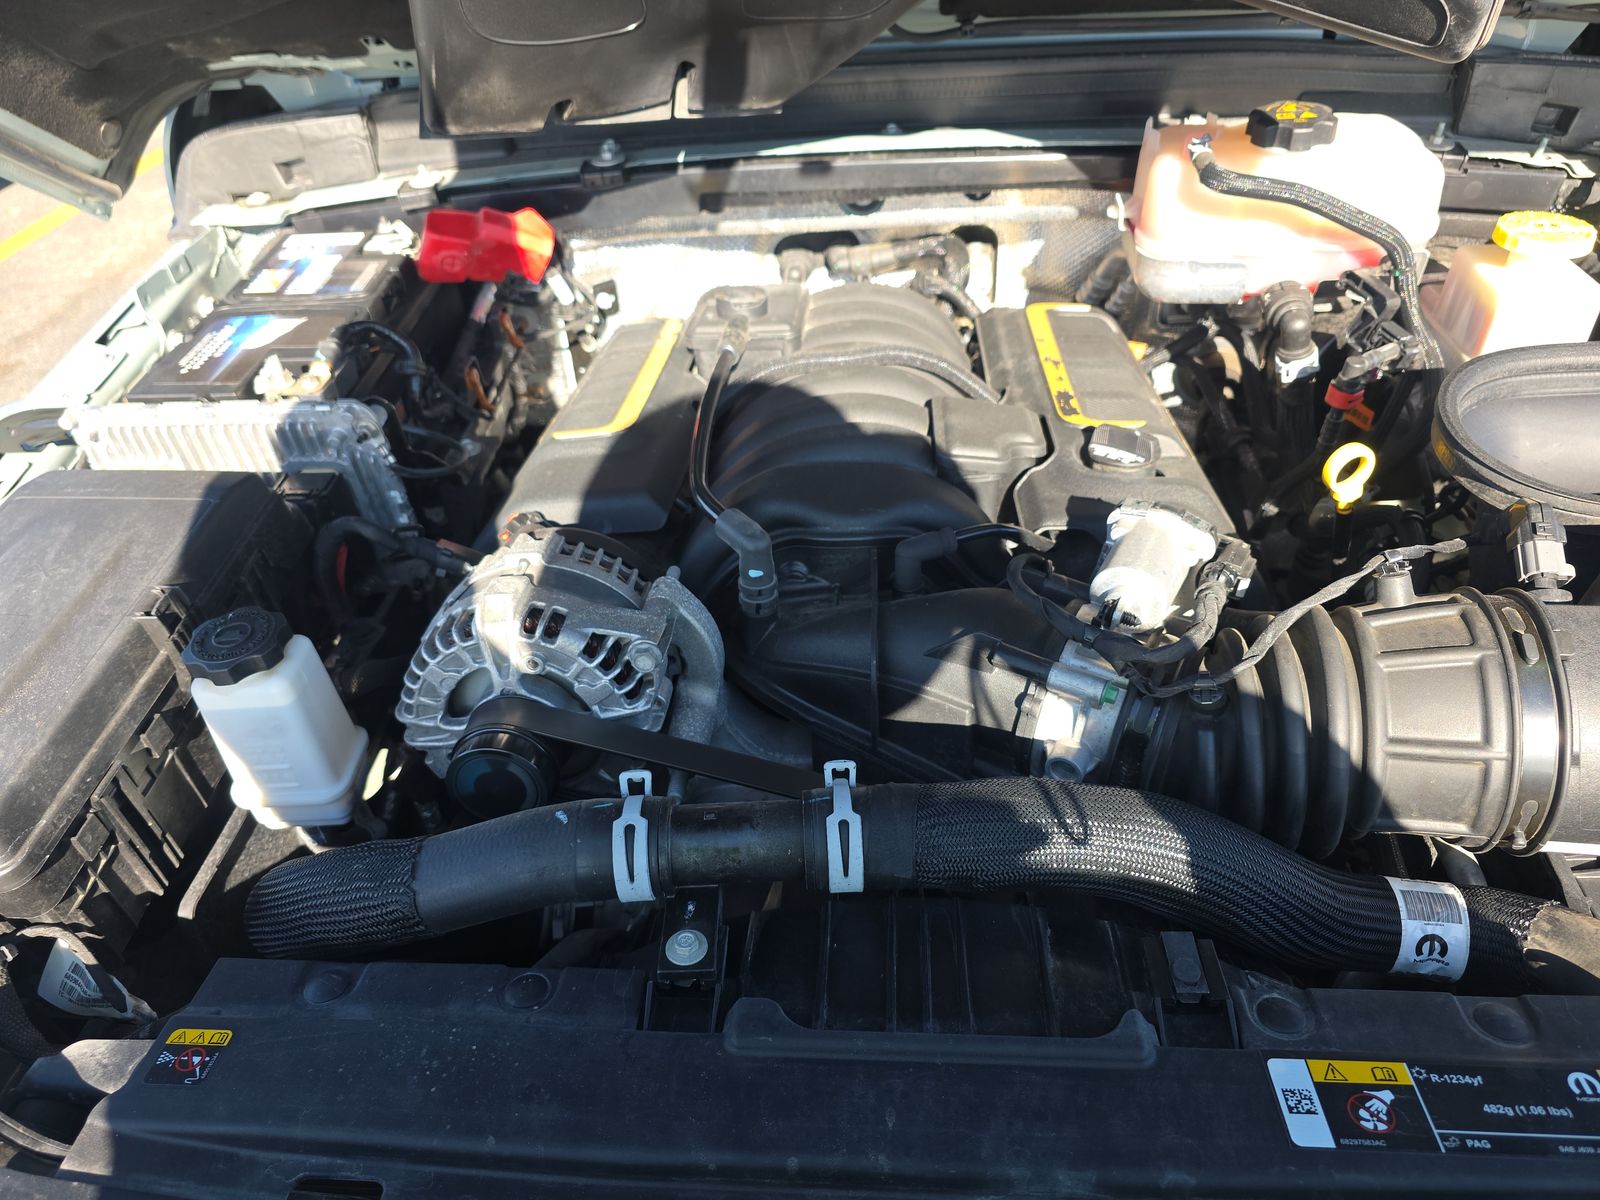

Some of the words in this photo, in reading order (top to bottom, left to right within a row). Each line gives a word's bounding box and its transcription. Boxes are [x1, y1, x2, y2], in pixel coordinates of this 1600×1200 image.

[1430, 1073, 1483, 1086] R-1234yf
[1483, 1104, 1513, 1116] 482g
[1515, 1104, 1546, 1116] (1.06
[1547, 1106, 1574, 1118] lbs)
[1465, 1138, 1491, 1149] PAG
